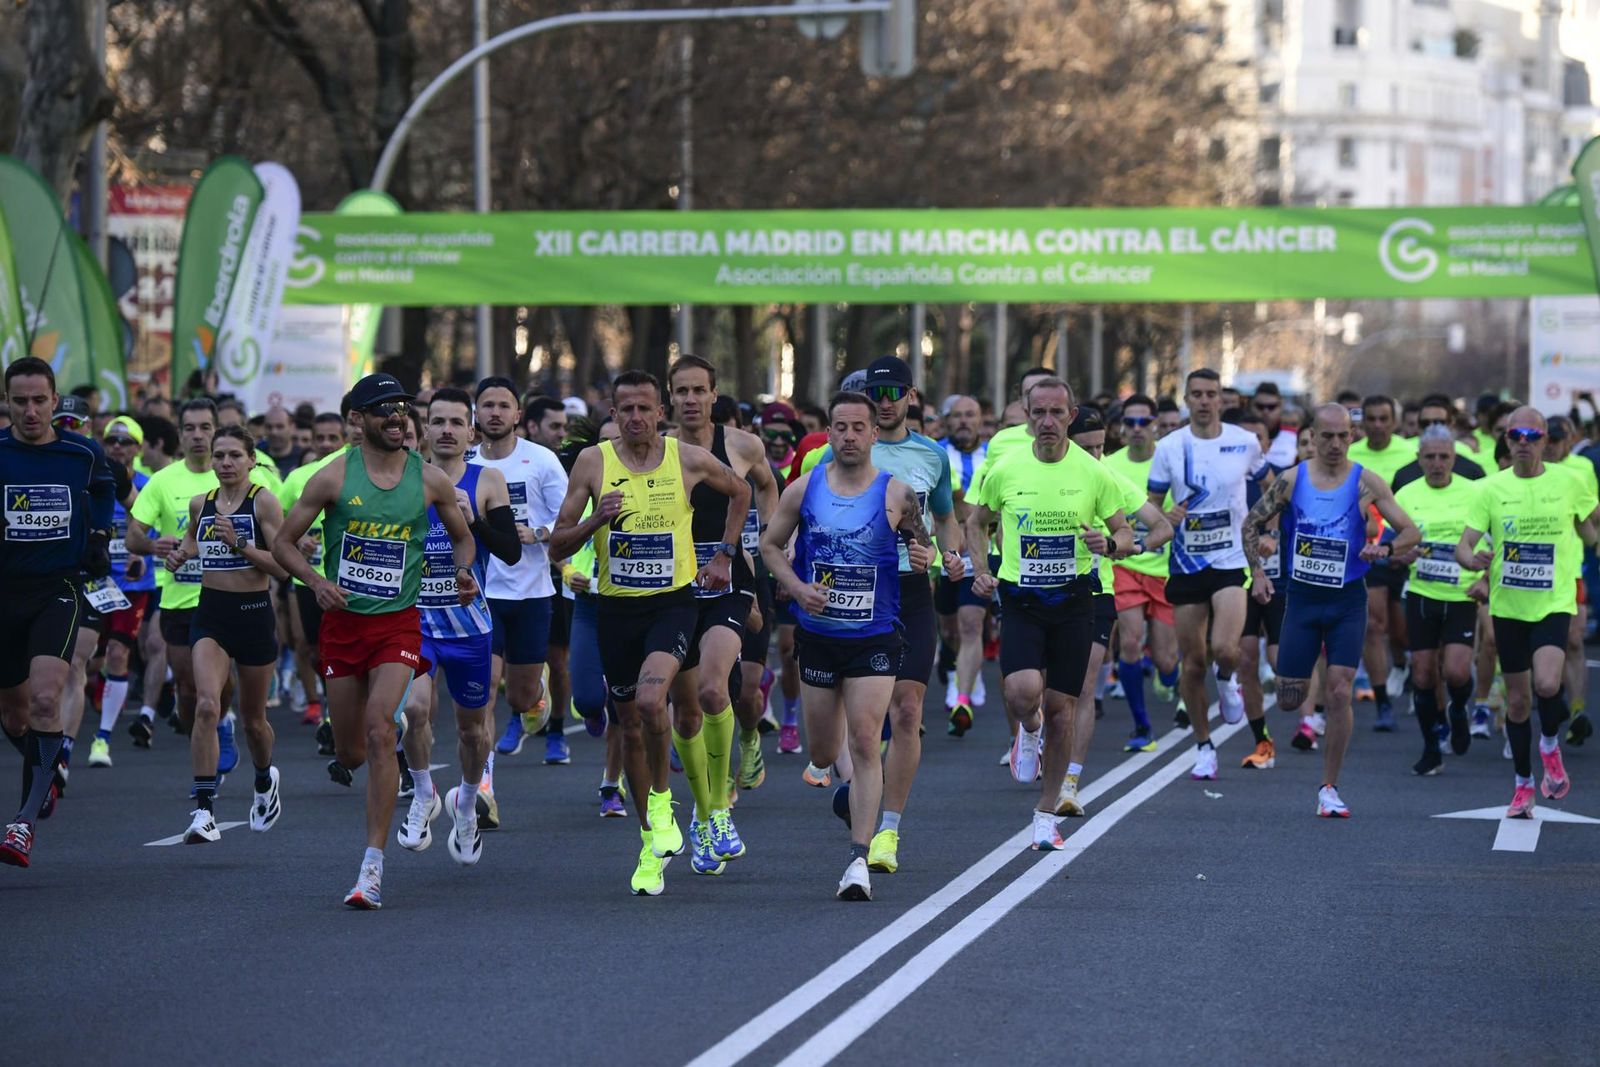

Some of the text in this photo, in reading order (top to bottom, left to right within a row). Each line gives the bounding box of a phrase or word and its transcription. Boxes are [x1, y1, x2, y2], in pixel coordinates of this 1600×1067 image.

[534, 219, 1337, 256] XII CARRERA MADRID EN MARCHA CONTRA EL CÁNCER
[334, 251, 386, 265] contra
[716, 260, 1153, 289] Asociación Española Contra el Cáncer
[1471, 260, 1529, 276] Madrid
[358, 268, 413, 283] Madrid
[16, 513, 60, 527] 18499
[635, 512, 665, 523] CLÍNICA
[634, 520, 676, 530] MENORCA
[1193, 530, 1224, 543] 23107
[620, 561, 663, 575] 17833
[1028, 562, 1067, 574] 23455
[1300, 559, 1336, 574] 18676
[1509, 565, 1545, 578] 16976
[347, 566, 393, 582] 20620
[240, 600, 268, 610] OYSHO
[823, 592, 864, 607] 8677
[804, 667, 833, 678] ATLETISM
